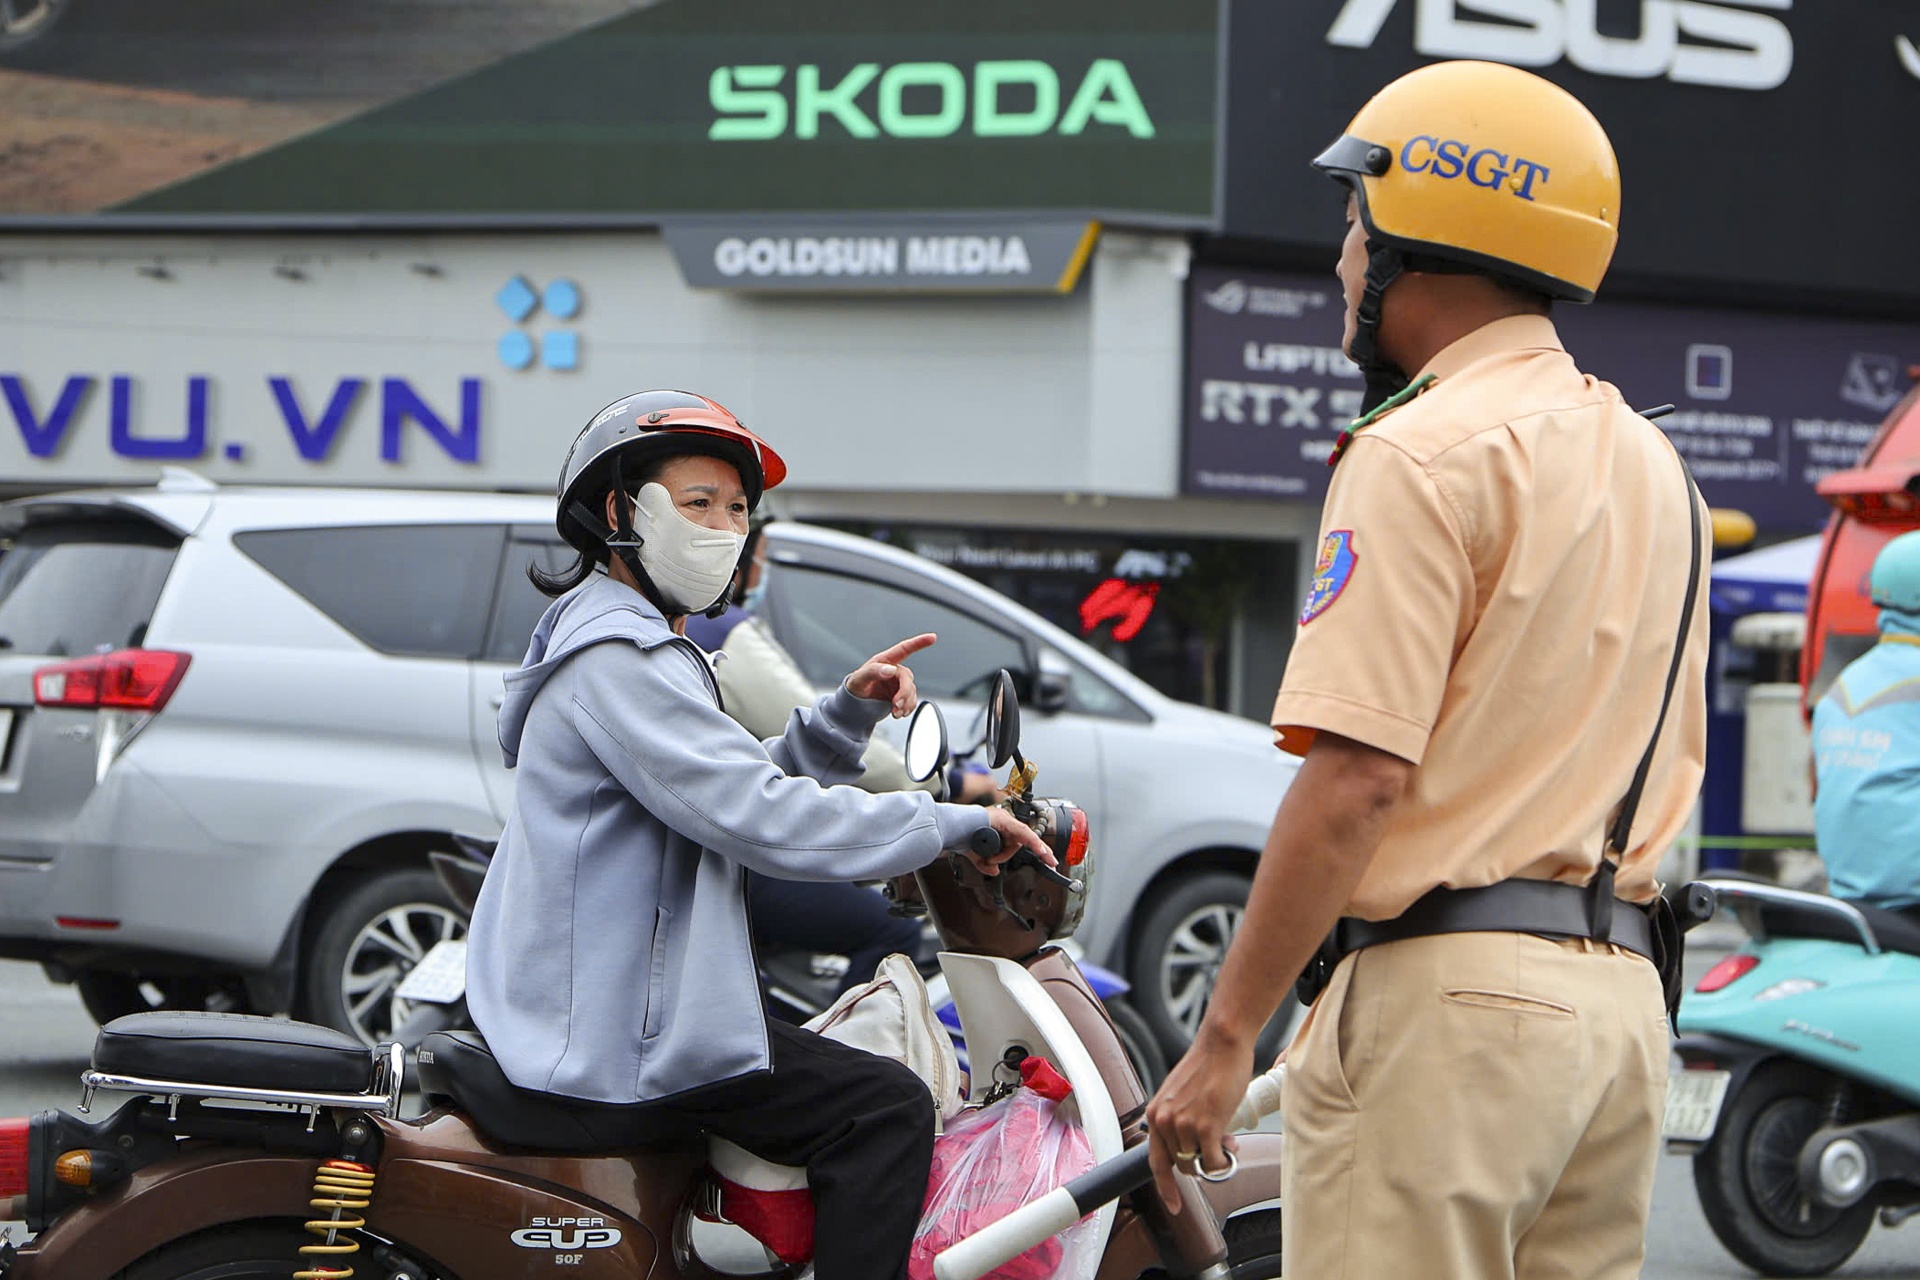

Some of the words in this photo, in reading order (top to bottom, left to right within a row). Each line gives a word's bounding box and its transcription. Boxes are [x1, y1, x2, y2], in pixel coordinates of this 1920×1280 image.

[708, 58, 1156, 140] SKODA
[1400, 134, 1550, 201] CSGT
[714, 237, 898, 277] GOLDSUN
[906, 236, 1032, 275] MEDIA
[0, 375, 481, 463] VU.VN
[1201, 379, 1320, 429] RTX
[531, 1216, 604, 1227] SUPER
[555, 1254, 584, 1265] 50F
